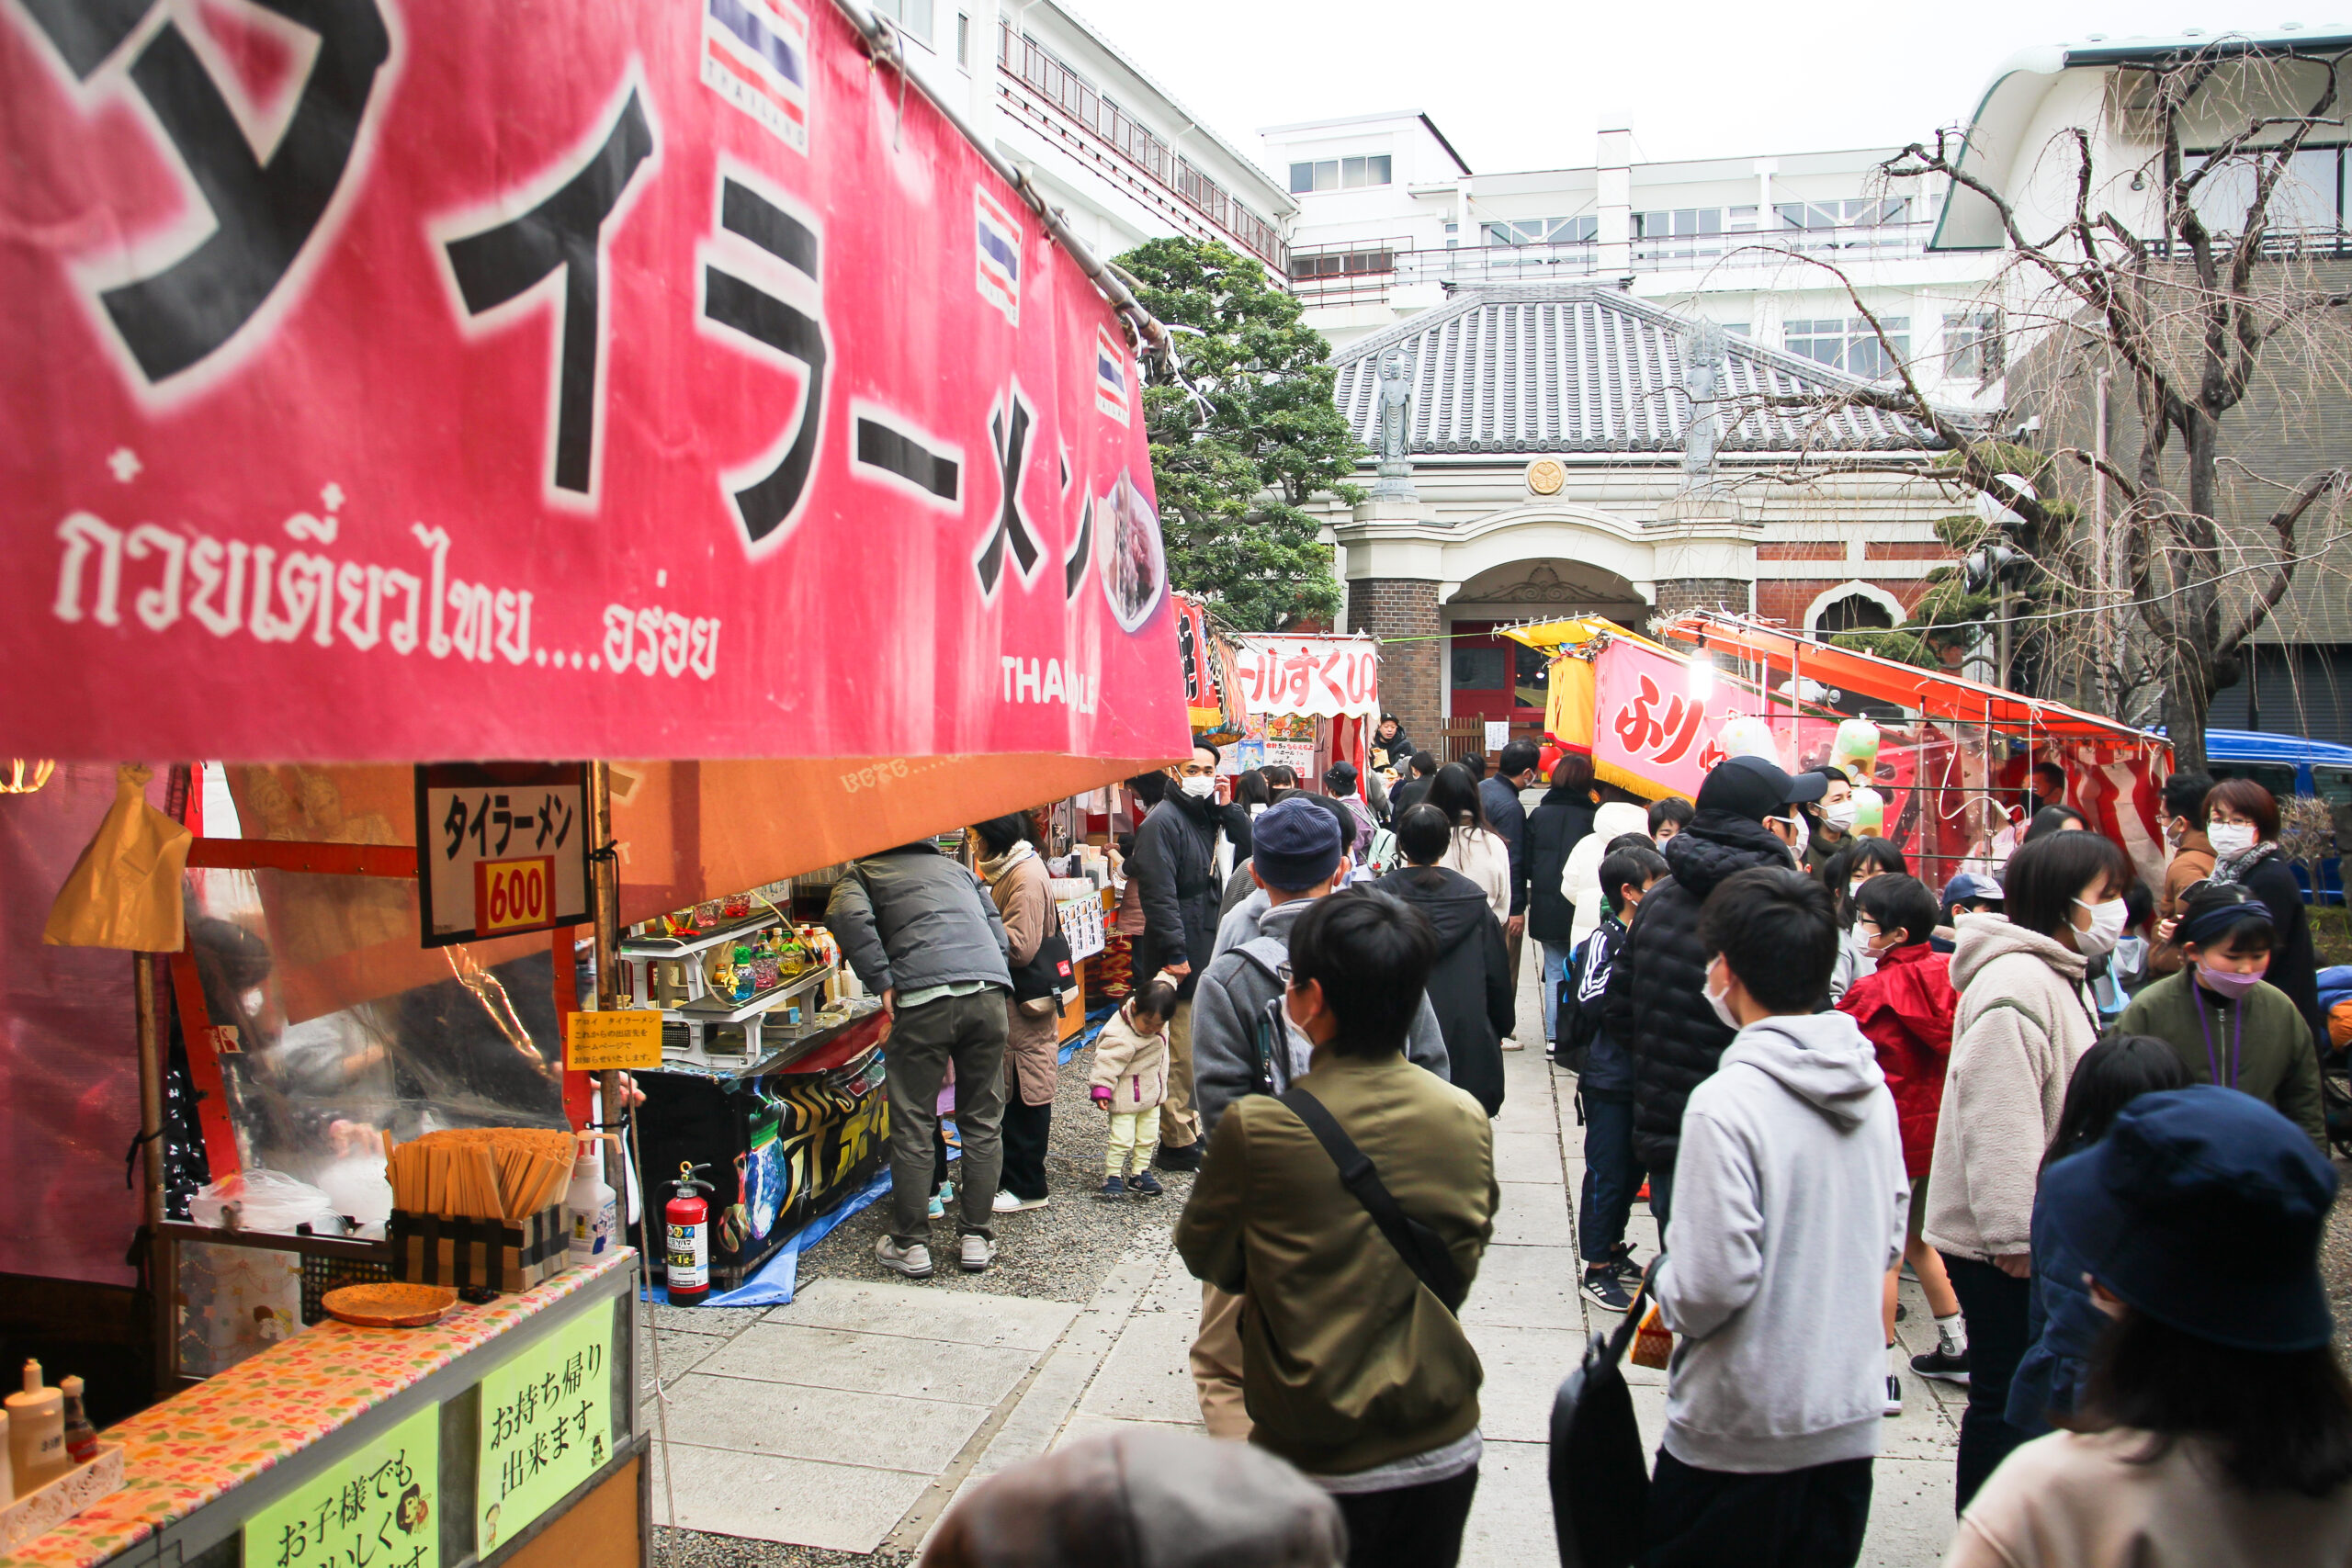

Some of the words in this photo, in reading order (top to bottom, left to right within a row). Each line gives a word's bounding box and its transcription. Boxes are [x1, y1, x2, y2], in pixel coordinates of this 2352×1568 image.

[444, 792, 573, 862] タイラーメン
[490, 867, 543, 924] 600
[574, 1029, 649, 1039] これからの出店先を
[574, 1041, 632, 1052] ホームページで
[608, 1016, 656, 1026] タイラーメン
[573, 1053, 651, 1065] お知らせいたします。
[491, 1343, 602, 1451] お持ち帰り
[502, 1399, 594, 1501] 出来ます
[277, 1449, 413, 1568] お子様でも
